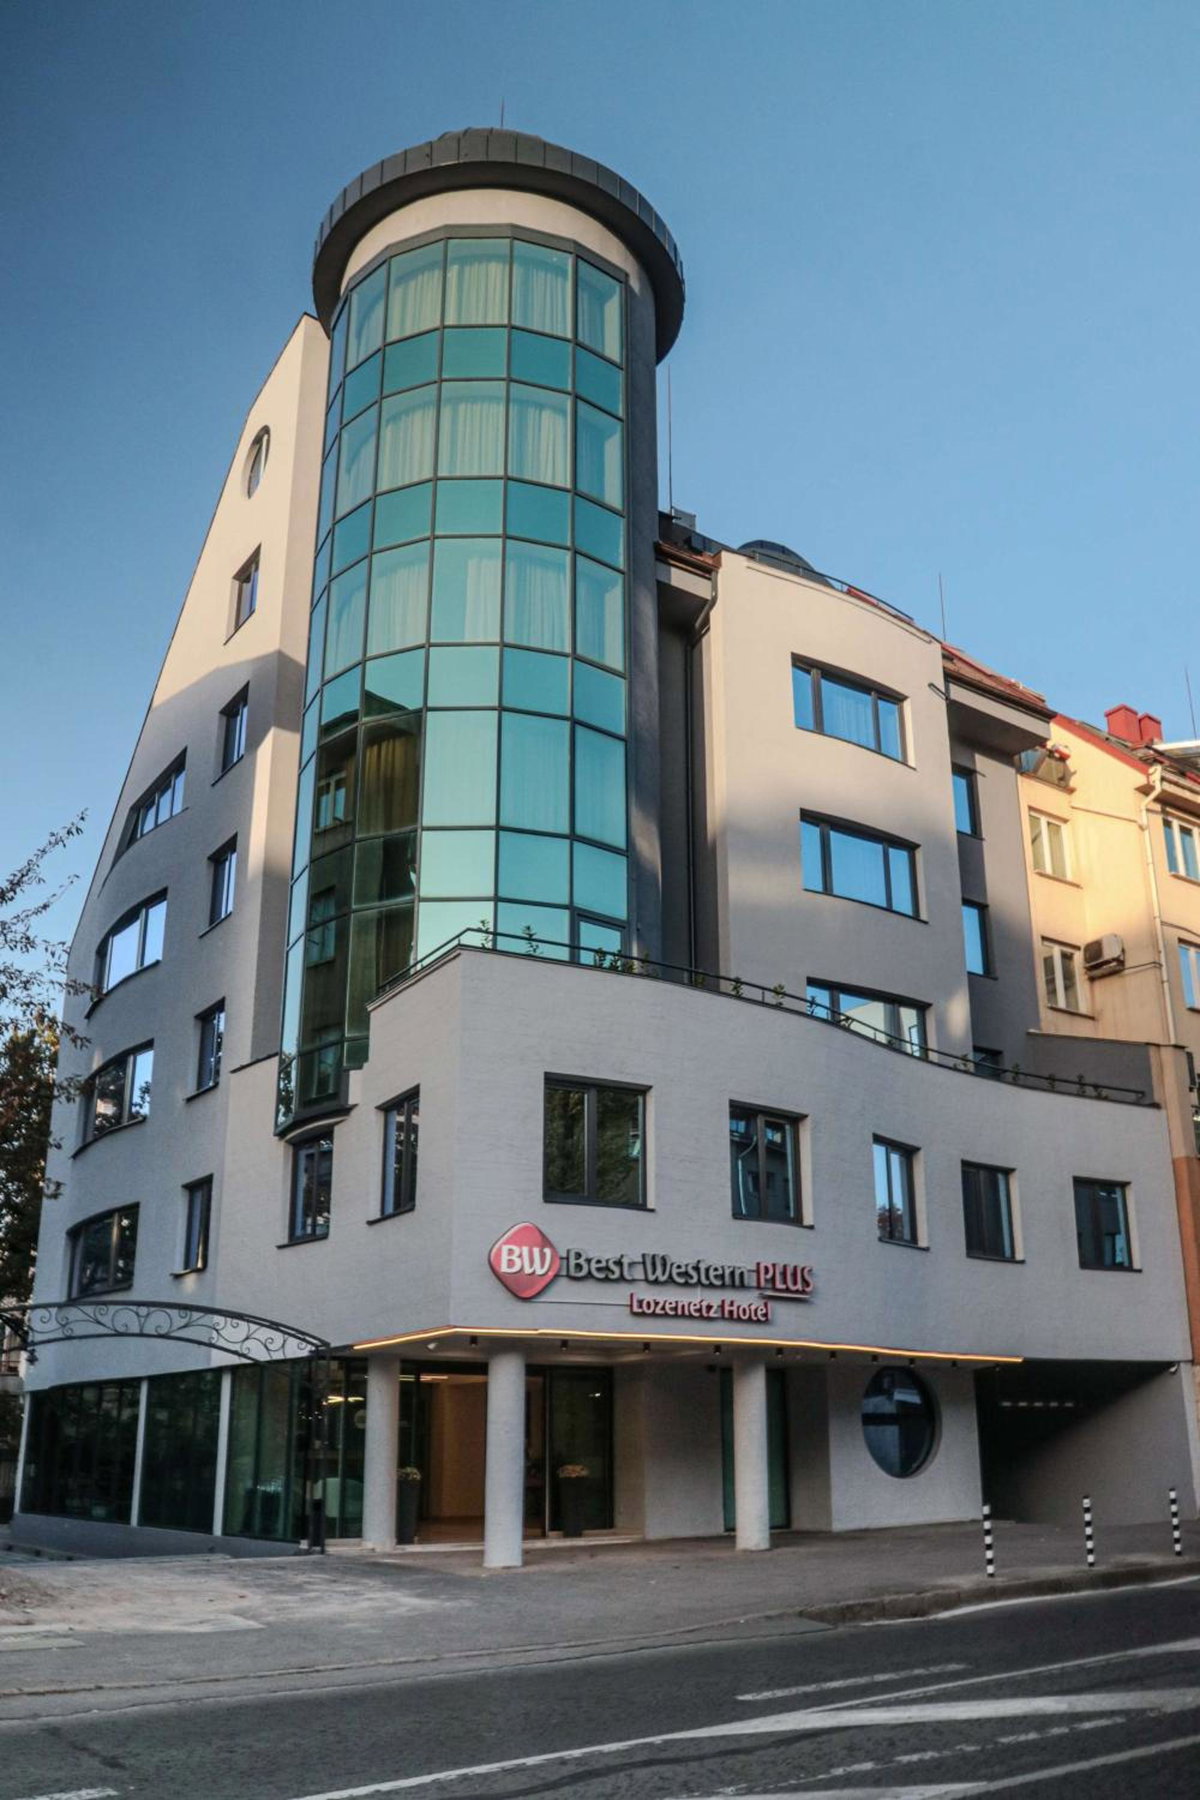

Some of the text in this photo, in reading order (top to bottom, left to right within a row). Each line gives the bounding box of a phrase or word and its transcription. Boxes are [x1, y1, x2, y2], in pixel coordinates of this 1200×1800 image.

[500, 1245, 551, 1276] BW
[567, 1248, 814, 1292] Best Western PLUS
[630, 1293, 771, 1322] Lozenetz Hotel
